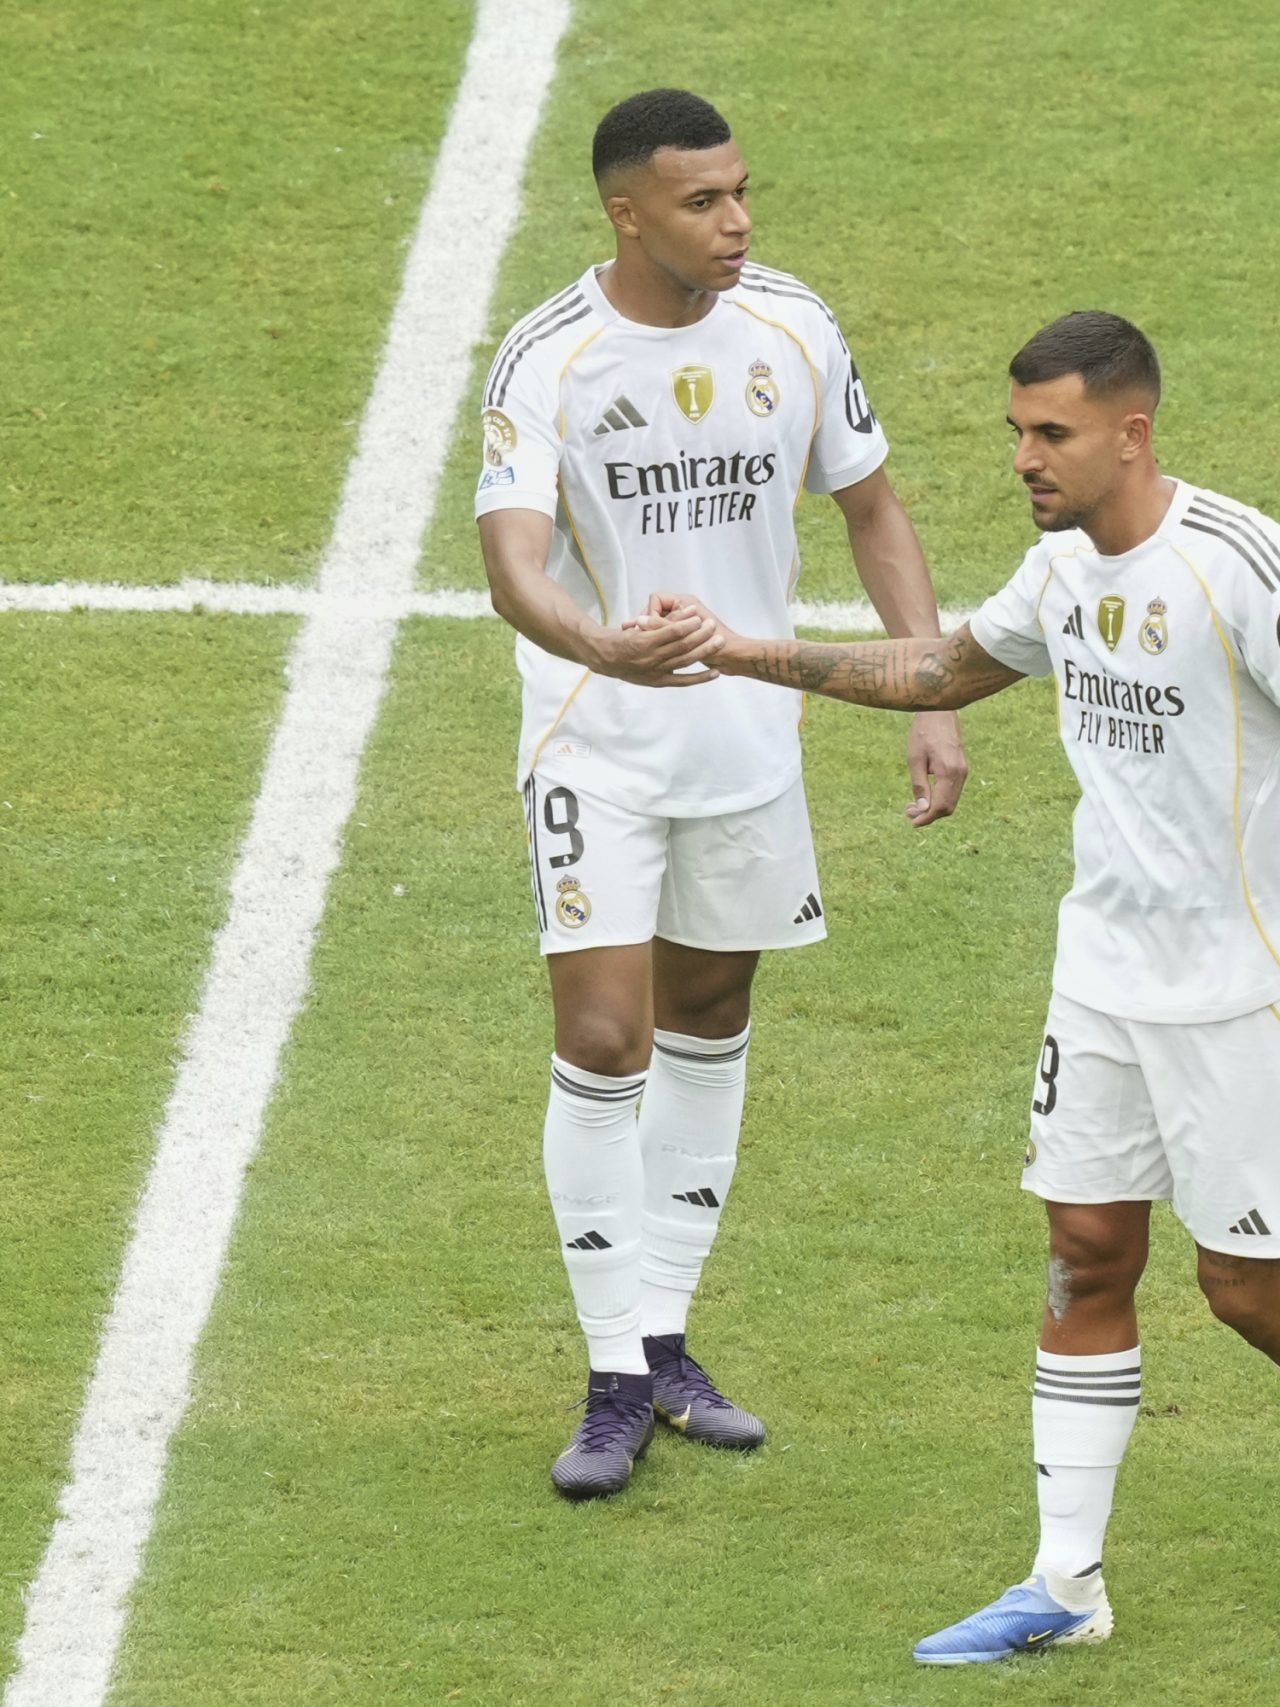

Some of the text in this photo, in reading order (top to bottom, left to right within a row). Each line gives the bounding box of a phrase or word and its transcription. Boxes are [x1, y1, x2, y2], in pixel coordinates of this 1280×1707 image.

[845, 358, 877, 433] h
[604, 450, 776, 500] Emirates
[641, 491, 757, 535] FLY BETTER
[1063, 659, 1185, 717] Emirates
[1077, 711, 1166, 754] FLY BETTER
[543, 786, 585, 869] 9
